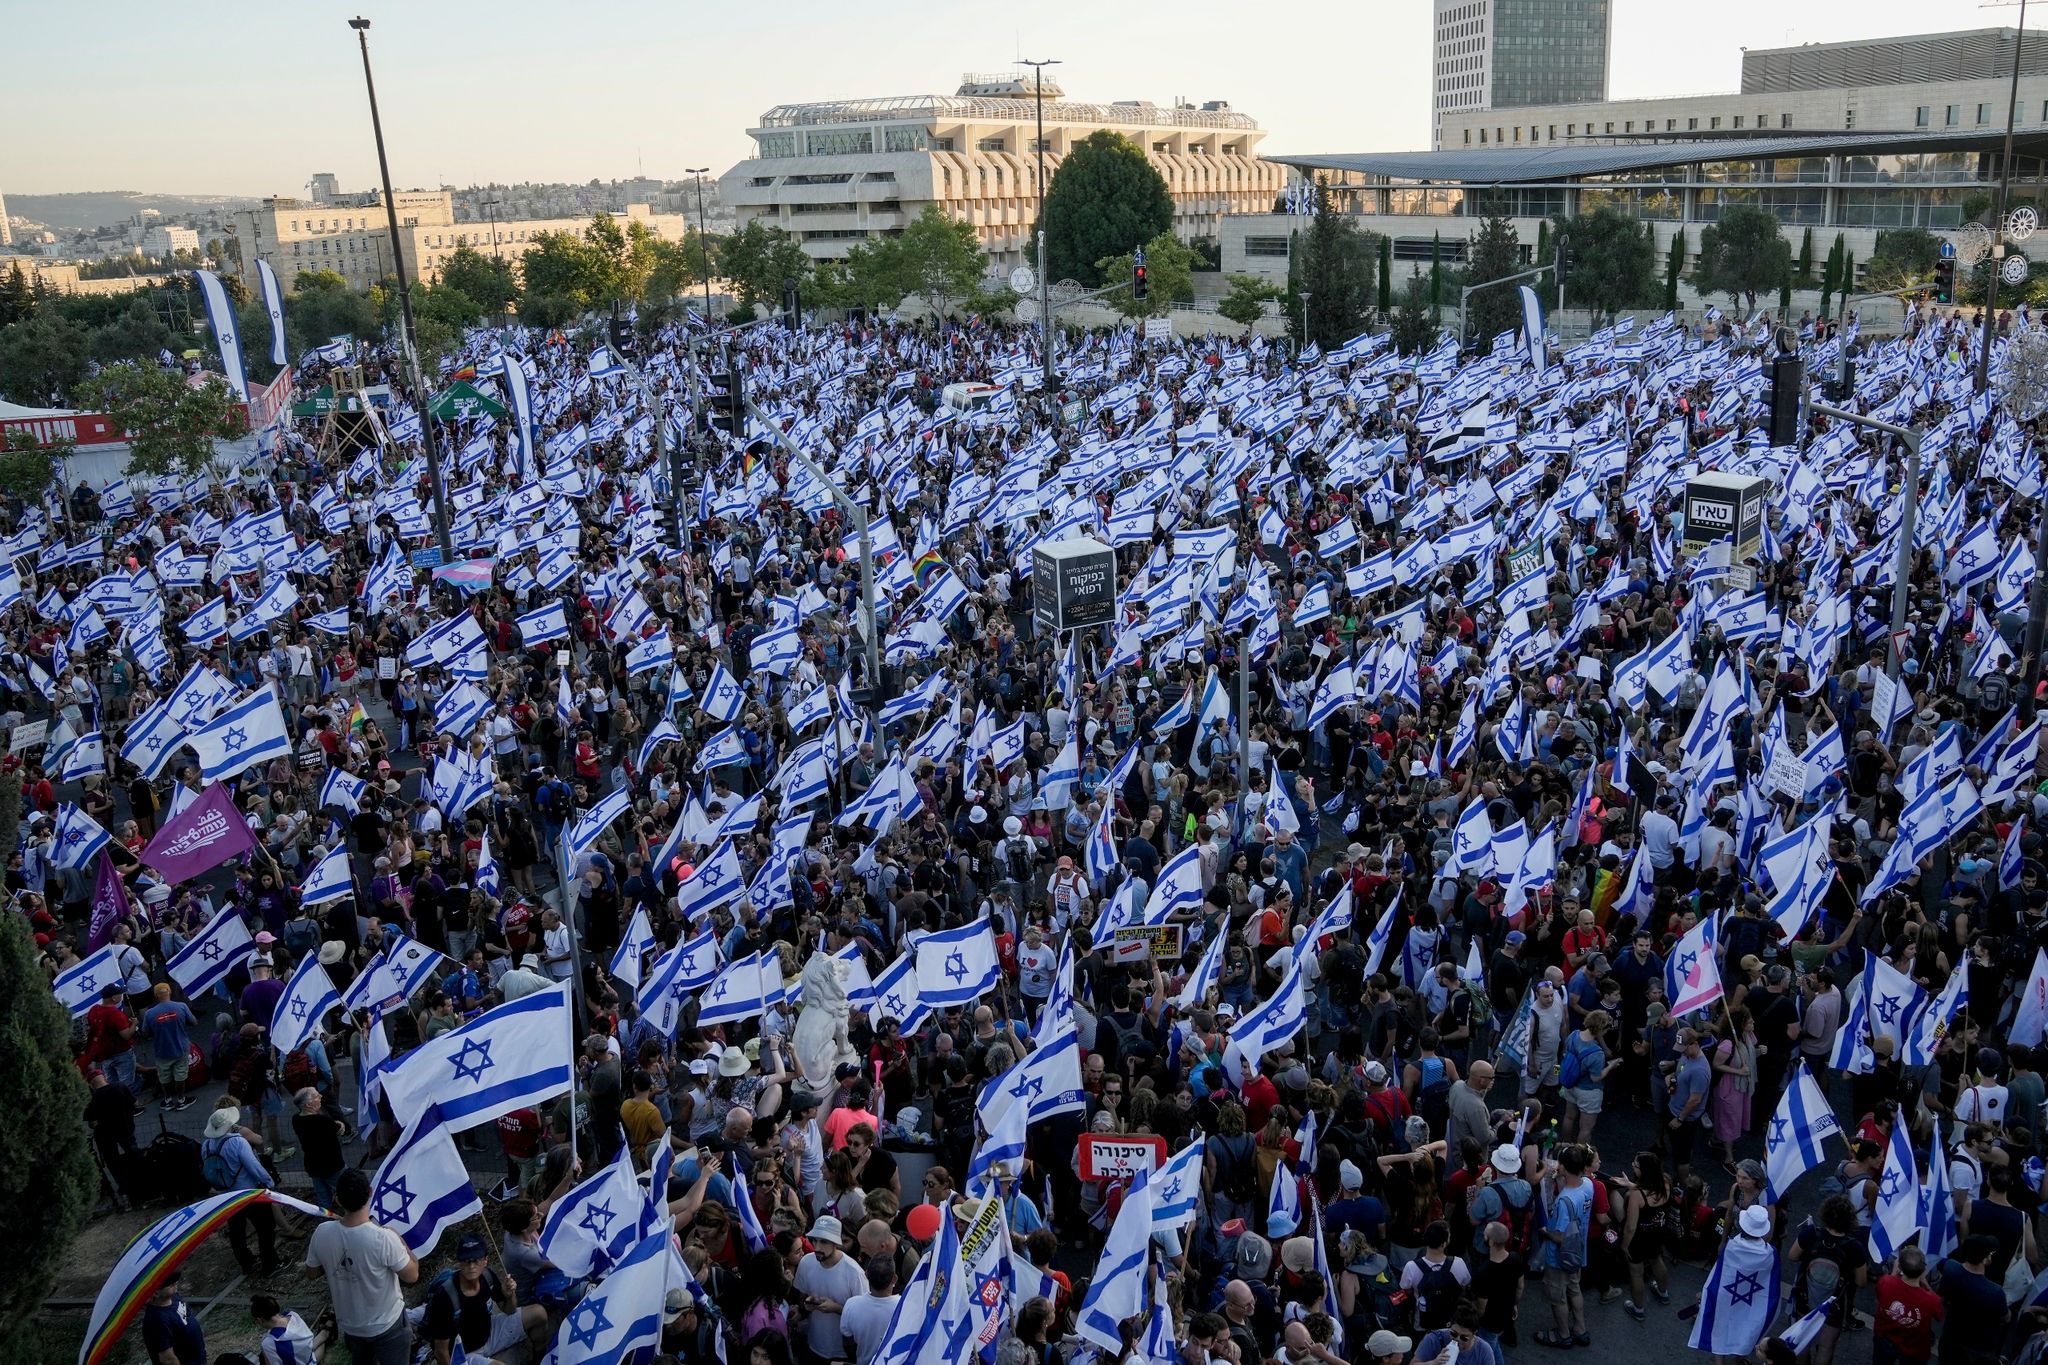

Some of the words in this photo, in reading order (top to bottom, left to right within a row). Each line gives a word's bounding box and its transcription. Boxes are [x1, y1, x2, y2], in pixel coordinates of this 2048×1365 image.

[1070, 571, 1105, 586] בפיקוח
[1075, 583, 1102, 595] רפואי
[191, 817, 227, 840] עומדים
[160, 840, 191, 856] ביחד
[1093, 1145, 1146, 1158] סיפורה
[1114, 1158, 1128, 1168] של
[1100, 1167, 1139, 1178] פיכה
